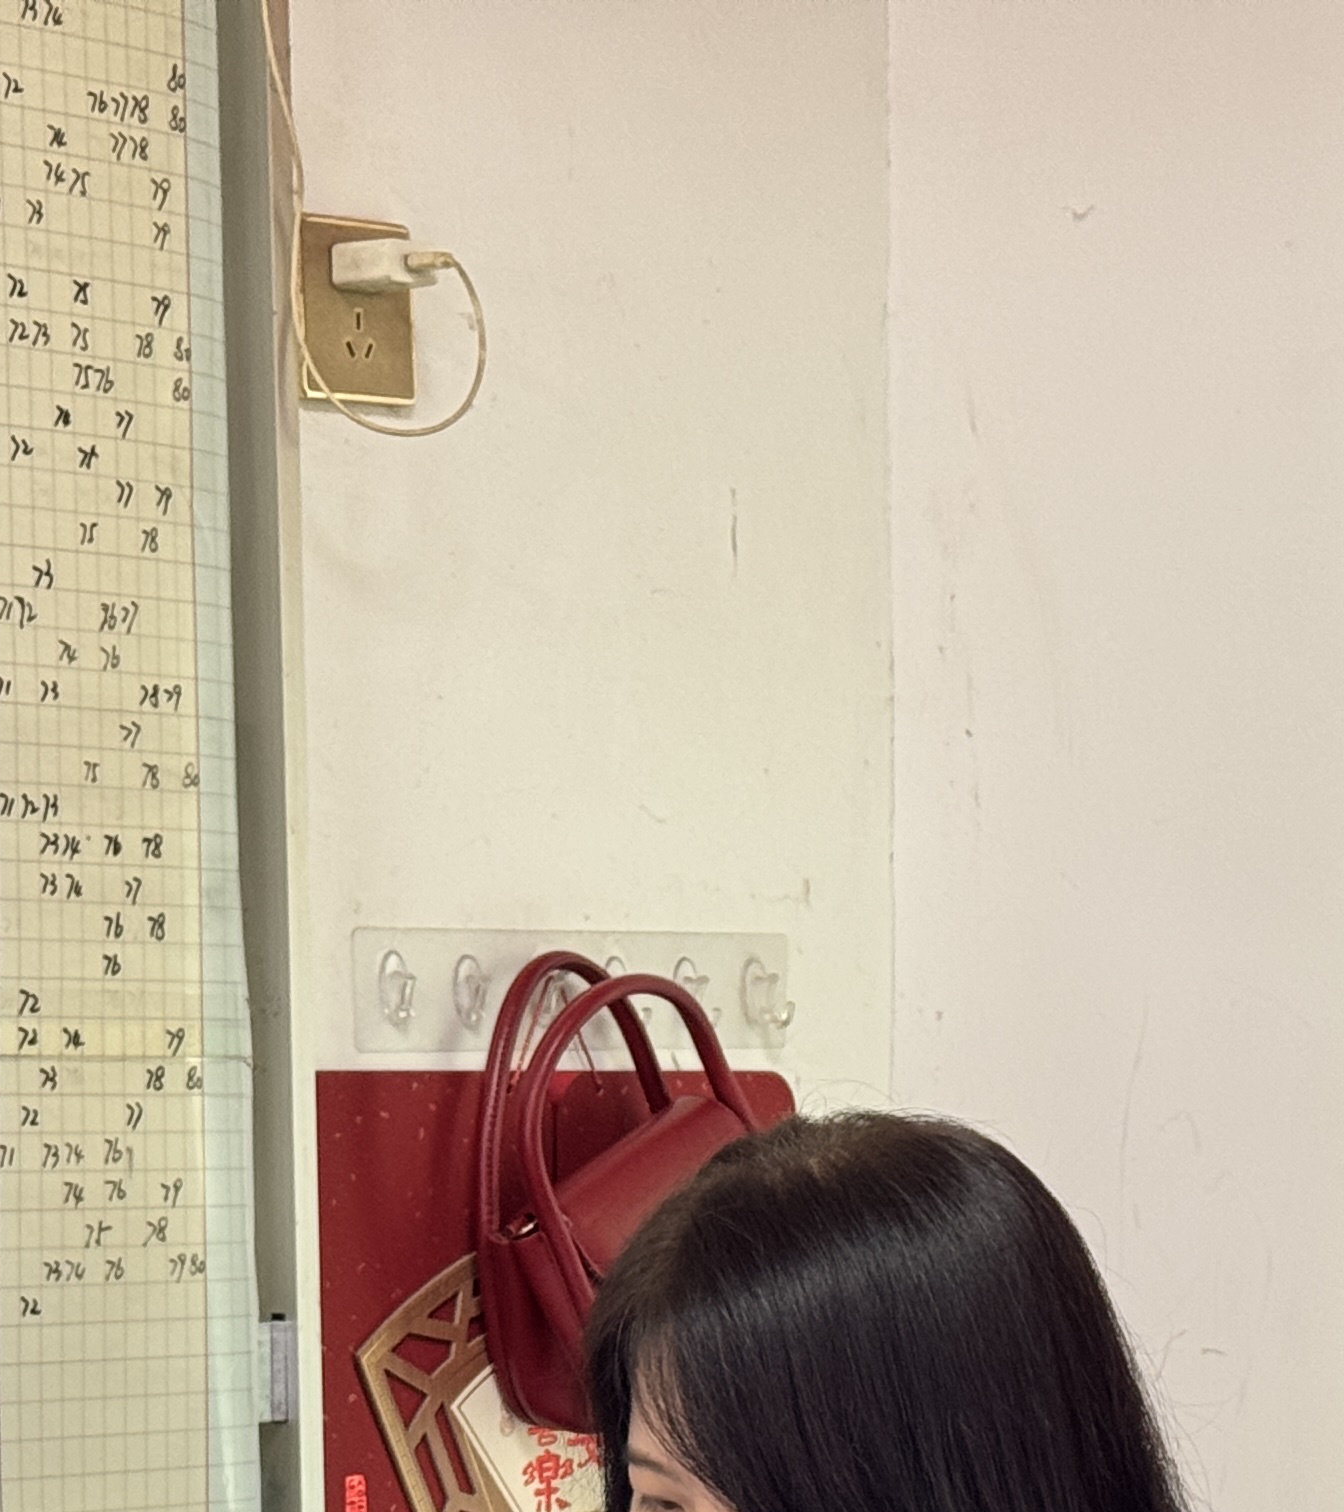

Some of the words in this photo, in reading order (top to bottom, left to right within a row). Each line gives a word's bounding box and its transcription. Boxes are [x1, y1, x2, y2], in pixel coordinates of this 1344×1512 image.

[25, 198, 44, 225] 73
[6, 272, 29, 299] 72
[119, 720, 142, 749] 77
[19, 1295, 42, 1318] 72
